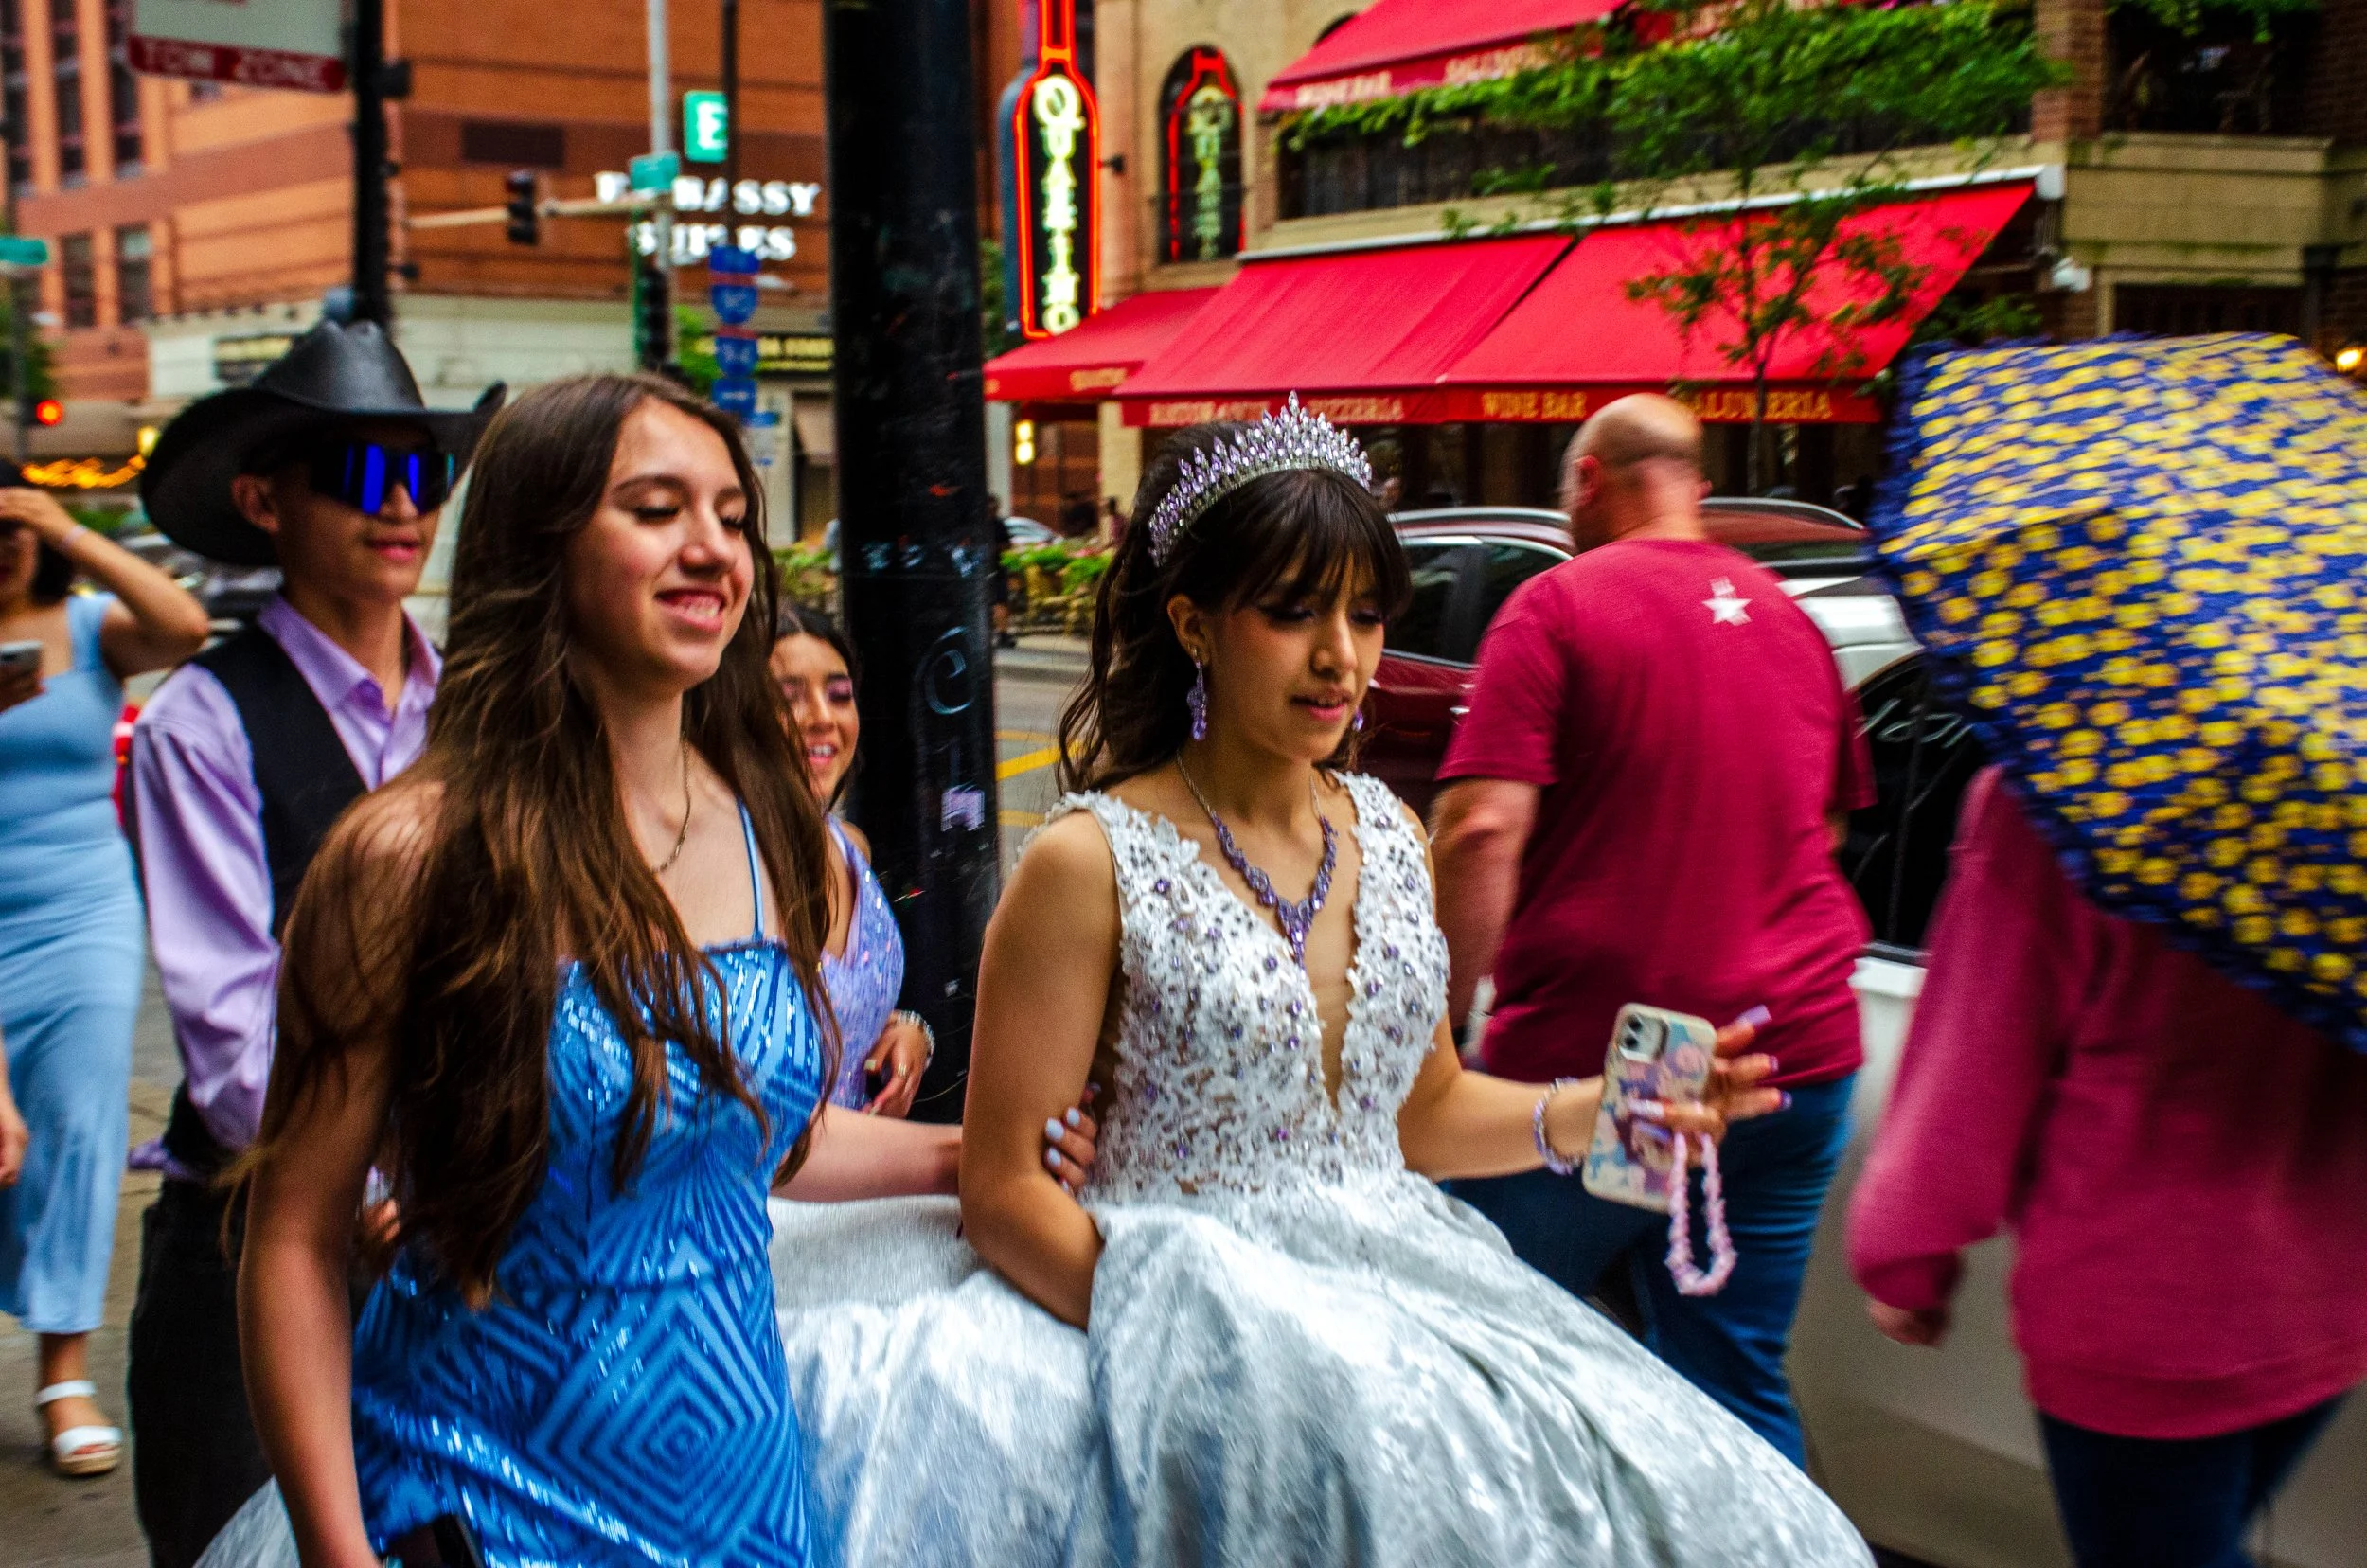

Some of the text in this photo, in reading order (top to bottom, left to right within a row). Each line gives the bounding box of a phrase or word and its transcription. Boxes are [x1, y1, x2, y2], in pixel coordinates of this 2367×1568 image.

[235, 49, 326, 93] ZONE
[697, 100, 728, 150] E
[594, 170, 821, 217] EBASSY
[1483, 391, 1539, 418] WINE
[1541, 391, 1587, 418] BAR
